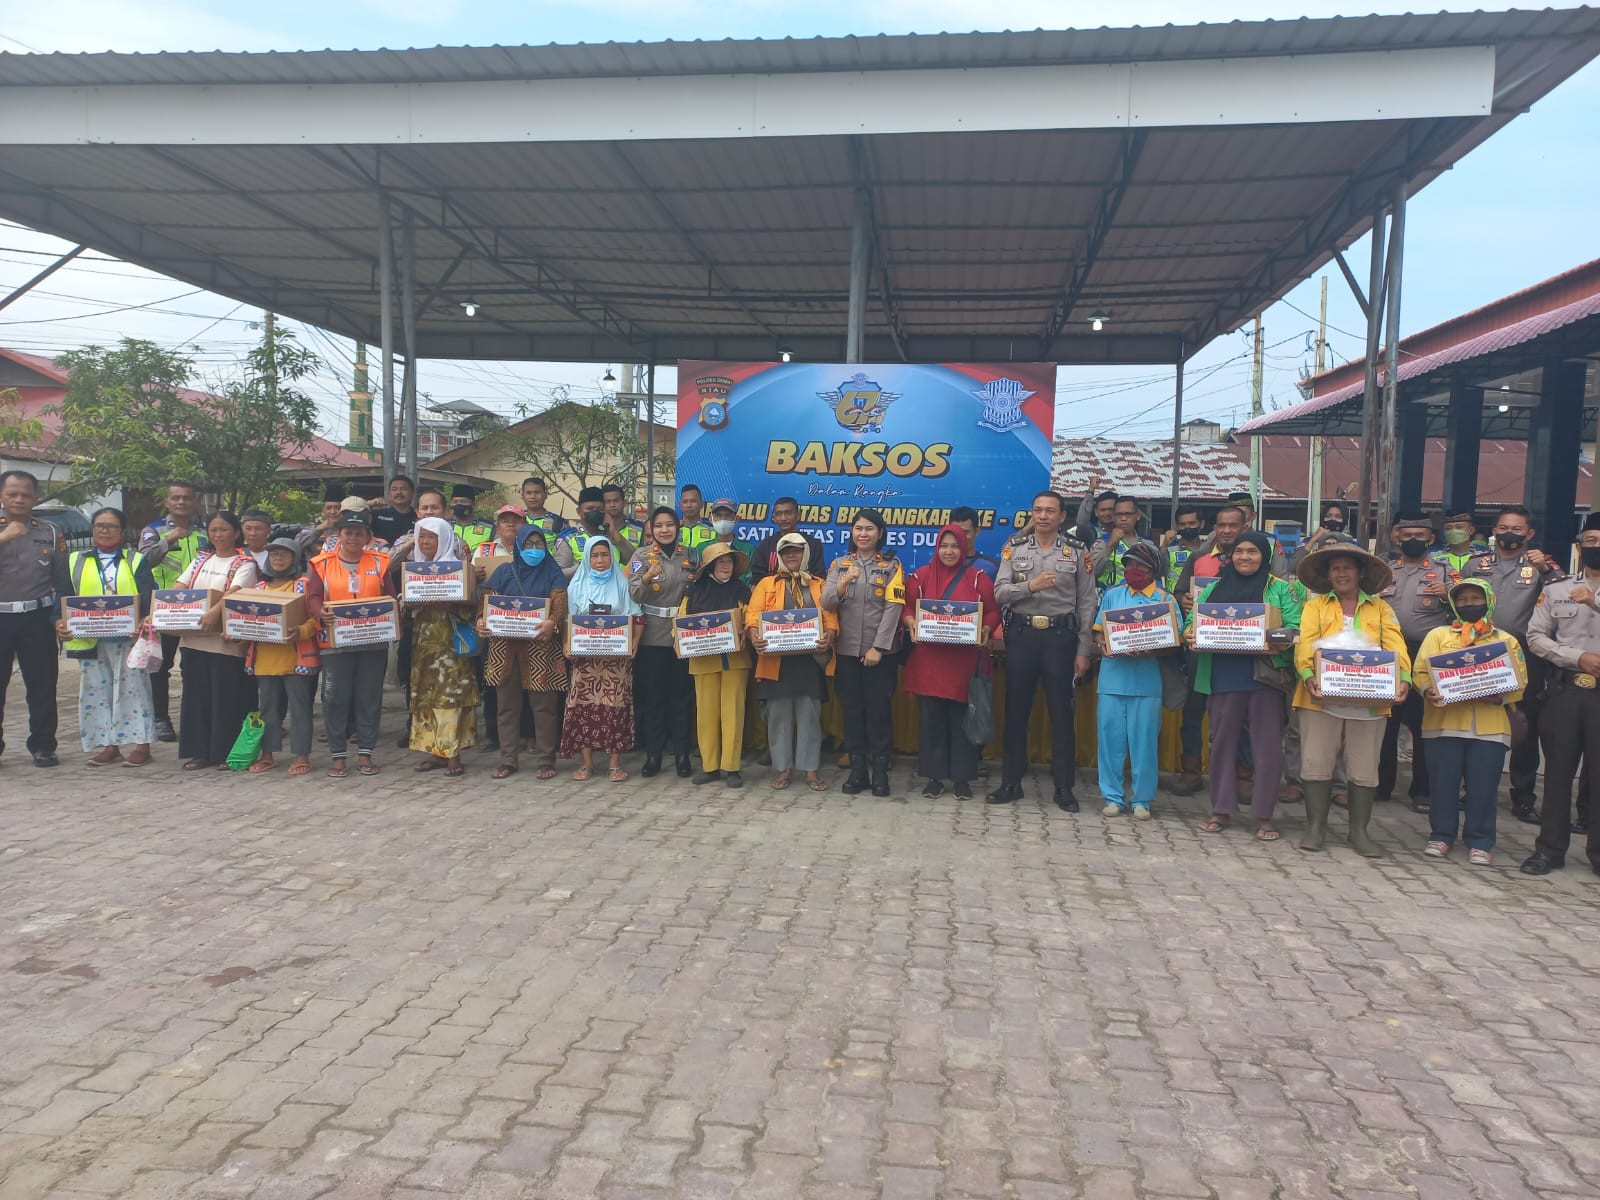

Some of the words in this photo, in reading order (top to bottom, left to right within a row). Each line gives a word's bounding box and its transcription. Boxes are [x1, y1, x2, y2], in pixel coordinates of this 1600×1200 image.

[765, 440, 951, 479] BAKSOS
[808, 483, 849, 496] Dalam
[853, 483, 901, 504] Rangka
[736, 503, 769, 521] ALU
[1200, 618, 1233, 626] BANTUAN
[1235, 618, 1260, 627] SOSIAL
[1325, 664, 1361, 673] BANTUAN
[1362, 665, 1390, 674] SOSIAL
[1439, 665, 1475, 679] BANTUAN
[1477, 659, 1506, 672] SOSIAL
